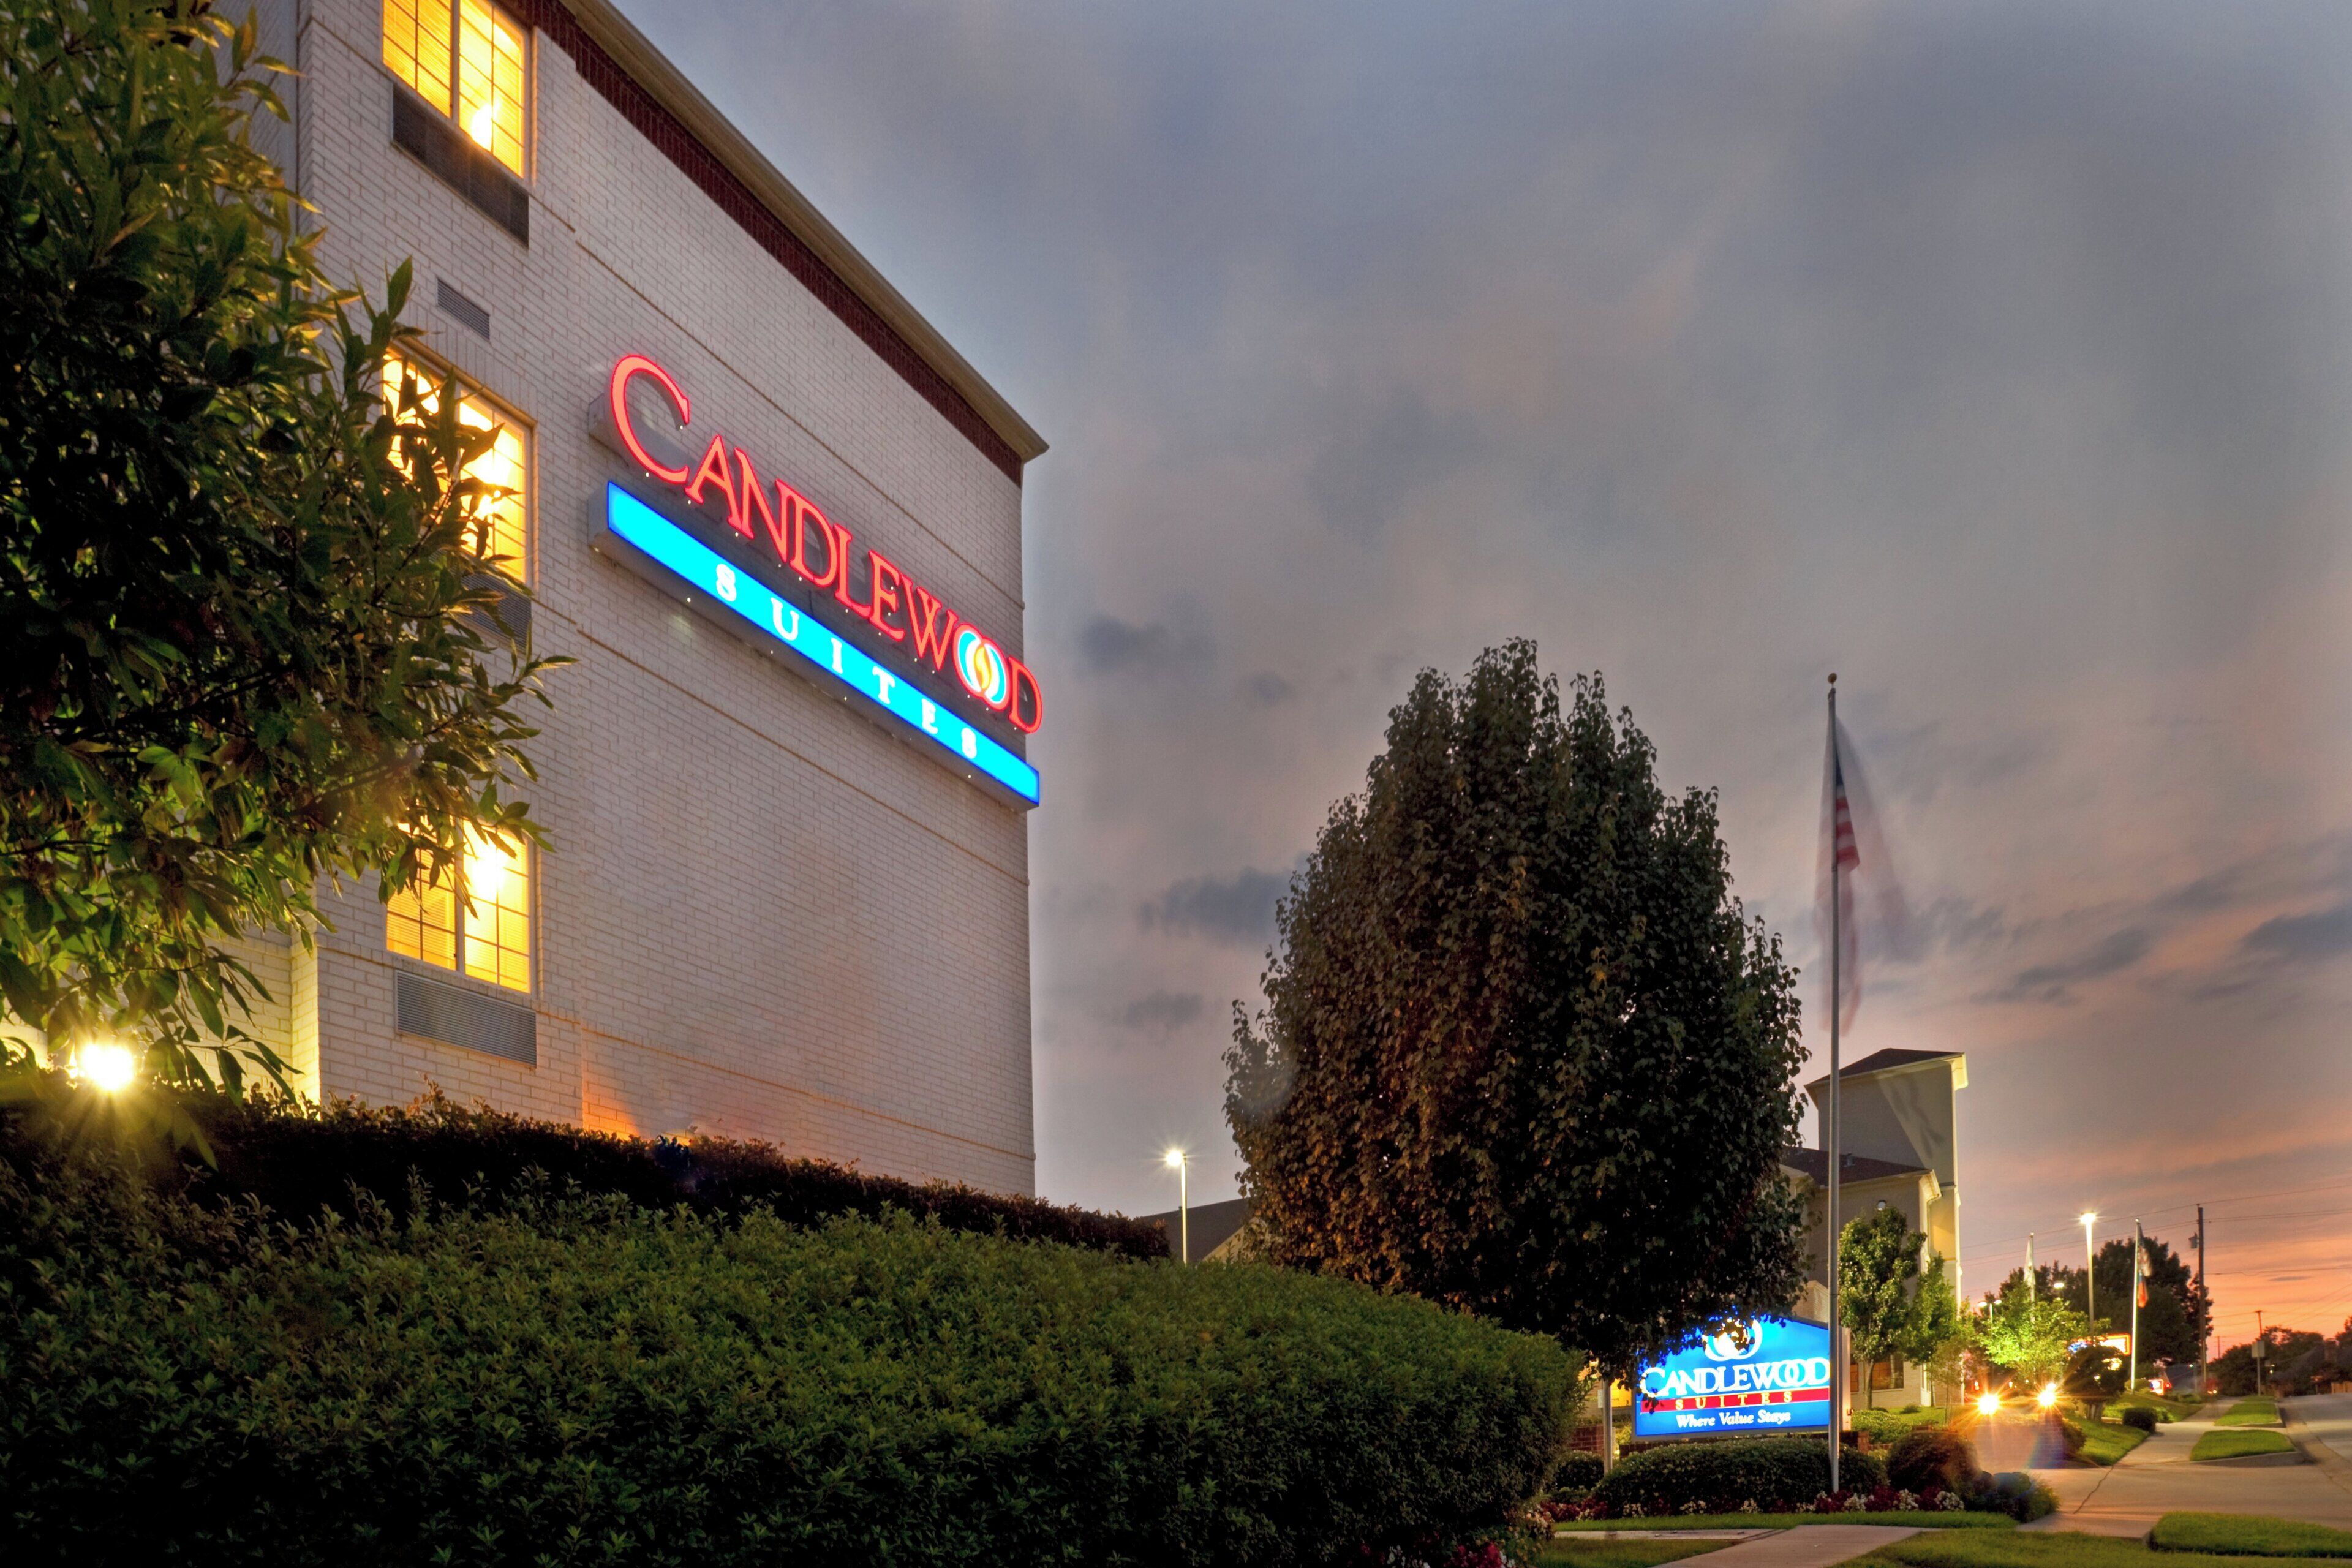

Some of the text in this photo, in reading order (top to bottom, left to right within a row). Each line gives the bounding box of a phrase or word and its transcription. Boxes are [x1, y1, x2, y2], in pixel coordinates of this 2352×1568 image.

[611, 354, 1043, 733] CANDLEWOOD
[715, 563, 978, 760] SUITES
[1640, 1357, 1830, 1398] CANDLEWOOD
[1675, 1390, 1792, 1411] SUITES
[1676, 1409, 1791, 1428] Where Value Stays
